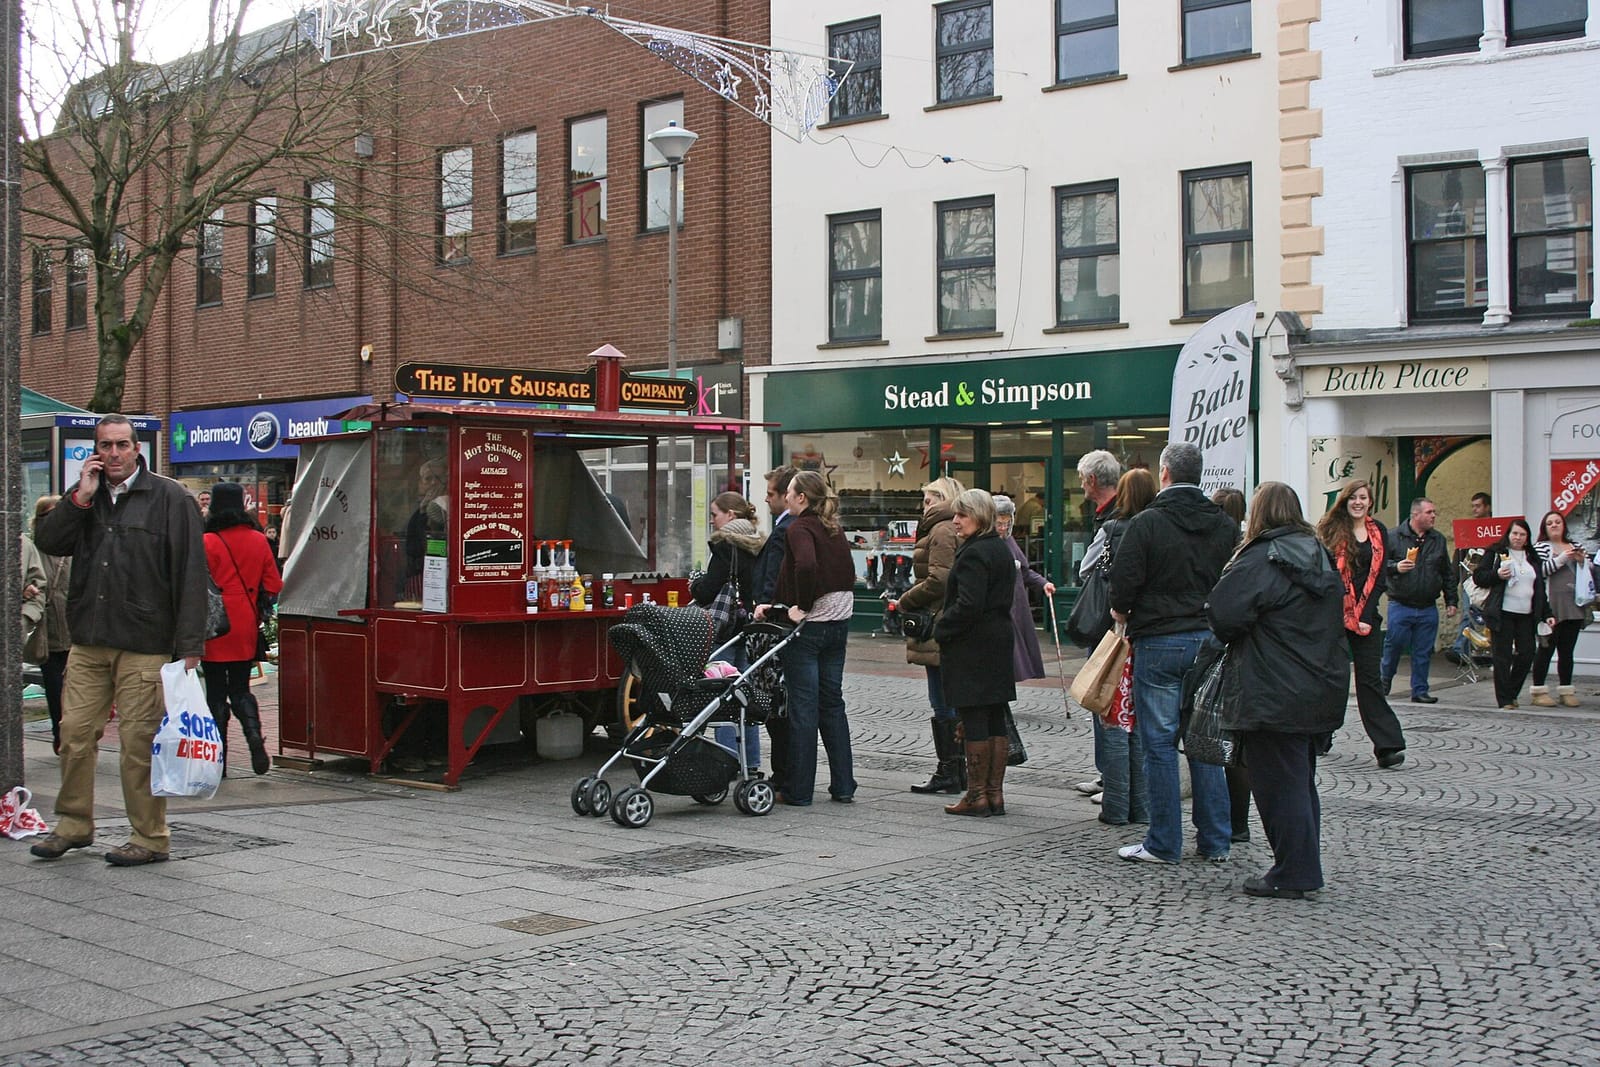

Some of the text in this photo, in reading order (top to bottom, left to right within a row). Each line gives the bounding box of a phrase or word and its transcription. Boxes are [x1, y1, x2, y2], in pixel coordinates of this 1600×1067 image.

[415, 369, 591, 399] THE HOT SAUSAGE
[1322, 362, 1469, 392] Bath Place
[621, 382, 687, 401] COMPANY
[884, 378, 1092, 410] Stead & Simpson
[1184, 370, 1244, 423] Bath
[71, 418, 96, 426] e-mail
[132, 420, 147, 428] one
[1572, 424, 1600, 439] FO
[190, 417, 328, 447] pharmacy Boots beauty
[486, 432, 502, 441] THE
[1183, 415, 1247, 450] Place
[464, 442, 523, 462] HOT SAUSAGE
[1203, 464, 1235, 479] nique
[309, 524, 338, 542] 986
[1477, 525, 1502, 538] SALE
